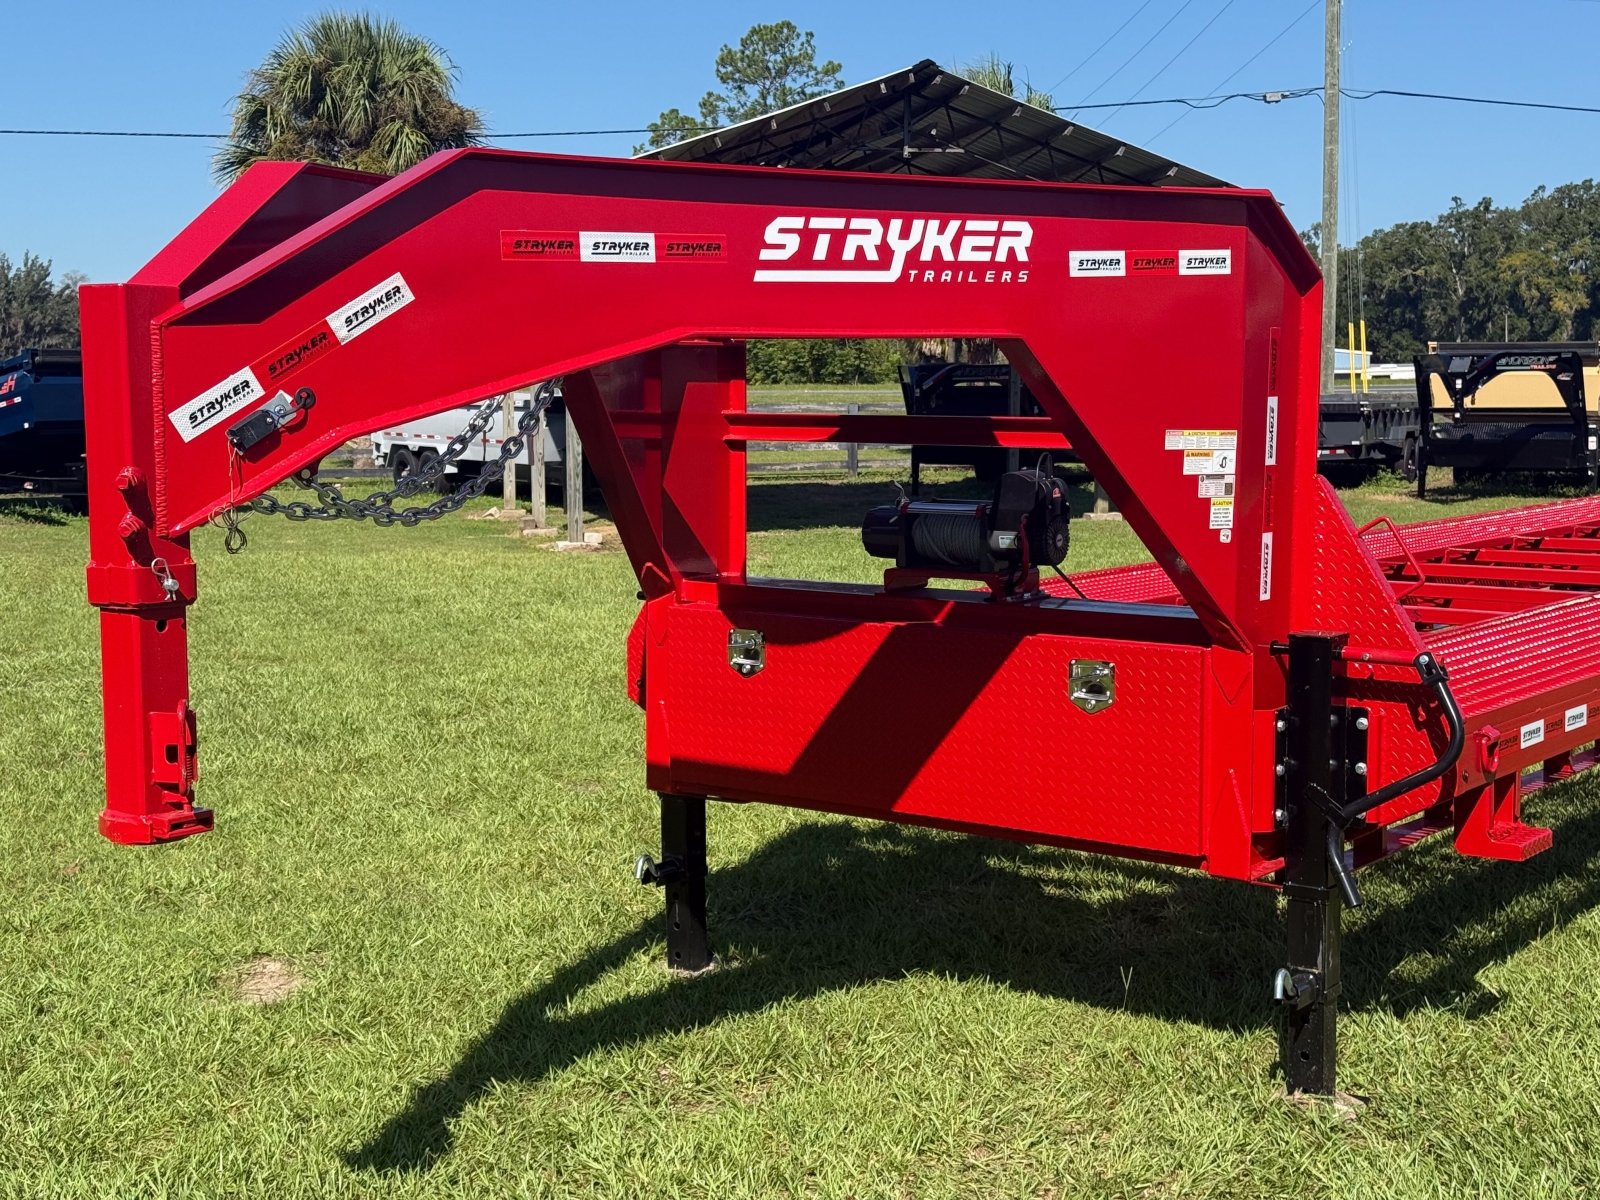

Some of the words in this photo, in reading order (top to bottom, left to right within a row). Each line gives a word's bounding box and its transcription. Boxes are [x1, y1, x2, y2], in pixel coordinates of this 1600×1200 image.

[512, 239, 574, 254] STRYKER
[591, 241, 650, 256] STRYKER
[664, 242, 722, 257] STRYKER
[753, 216, 1034, 282] STRYKER
[1077, 258, 1121, 271] STRYKER
[1133, 257, 1175, 270] STRYKER
[1186, 257, 1227, 269] STRYKER
[908, 270, 1029, 283] TRAILERS
[345, 285, 401, 333] STRYKER
[268, 332, 327, 380] STRYKER
[189, 379, 250, 430] STRYKER
[1268, 405, 1276, 460] STRYKER
[1262, 541, 1270, 595] STRYKER
